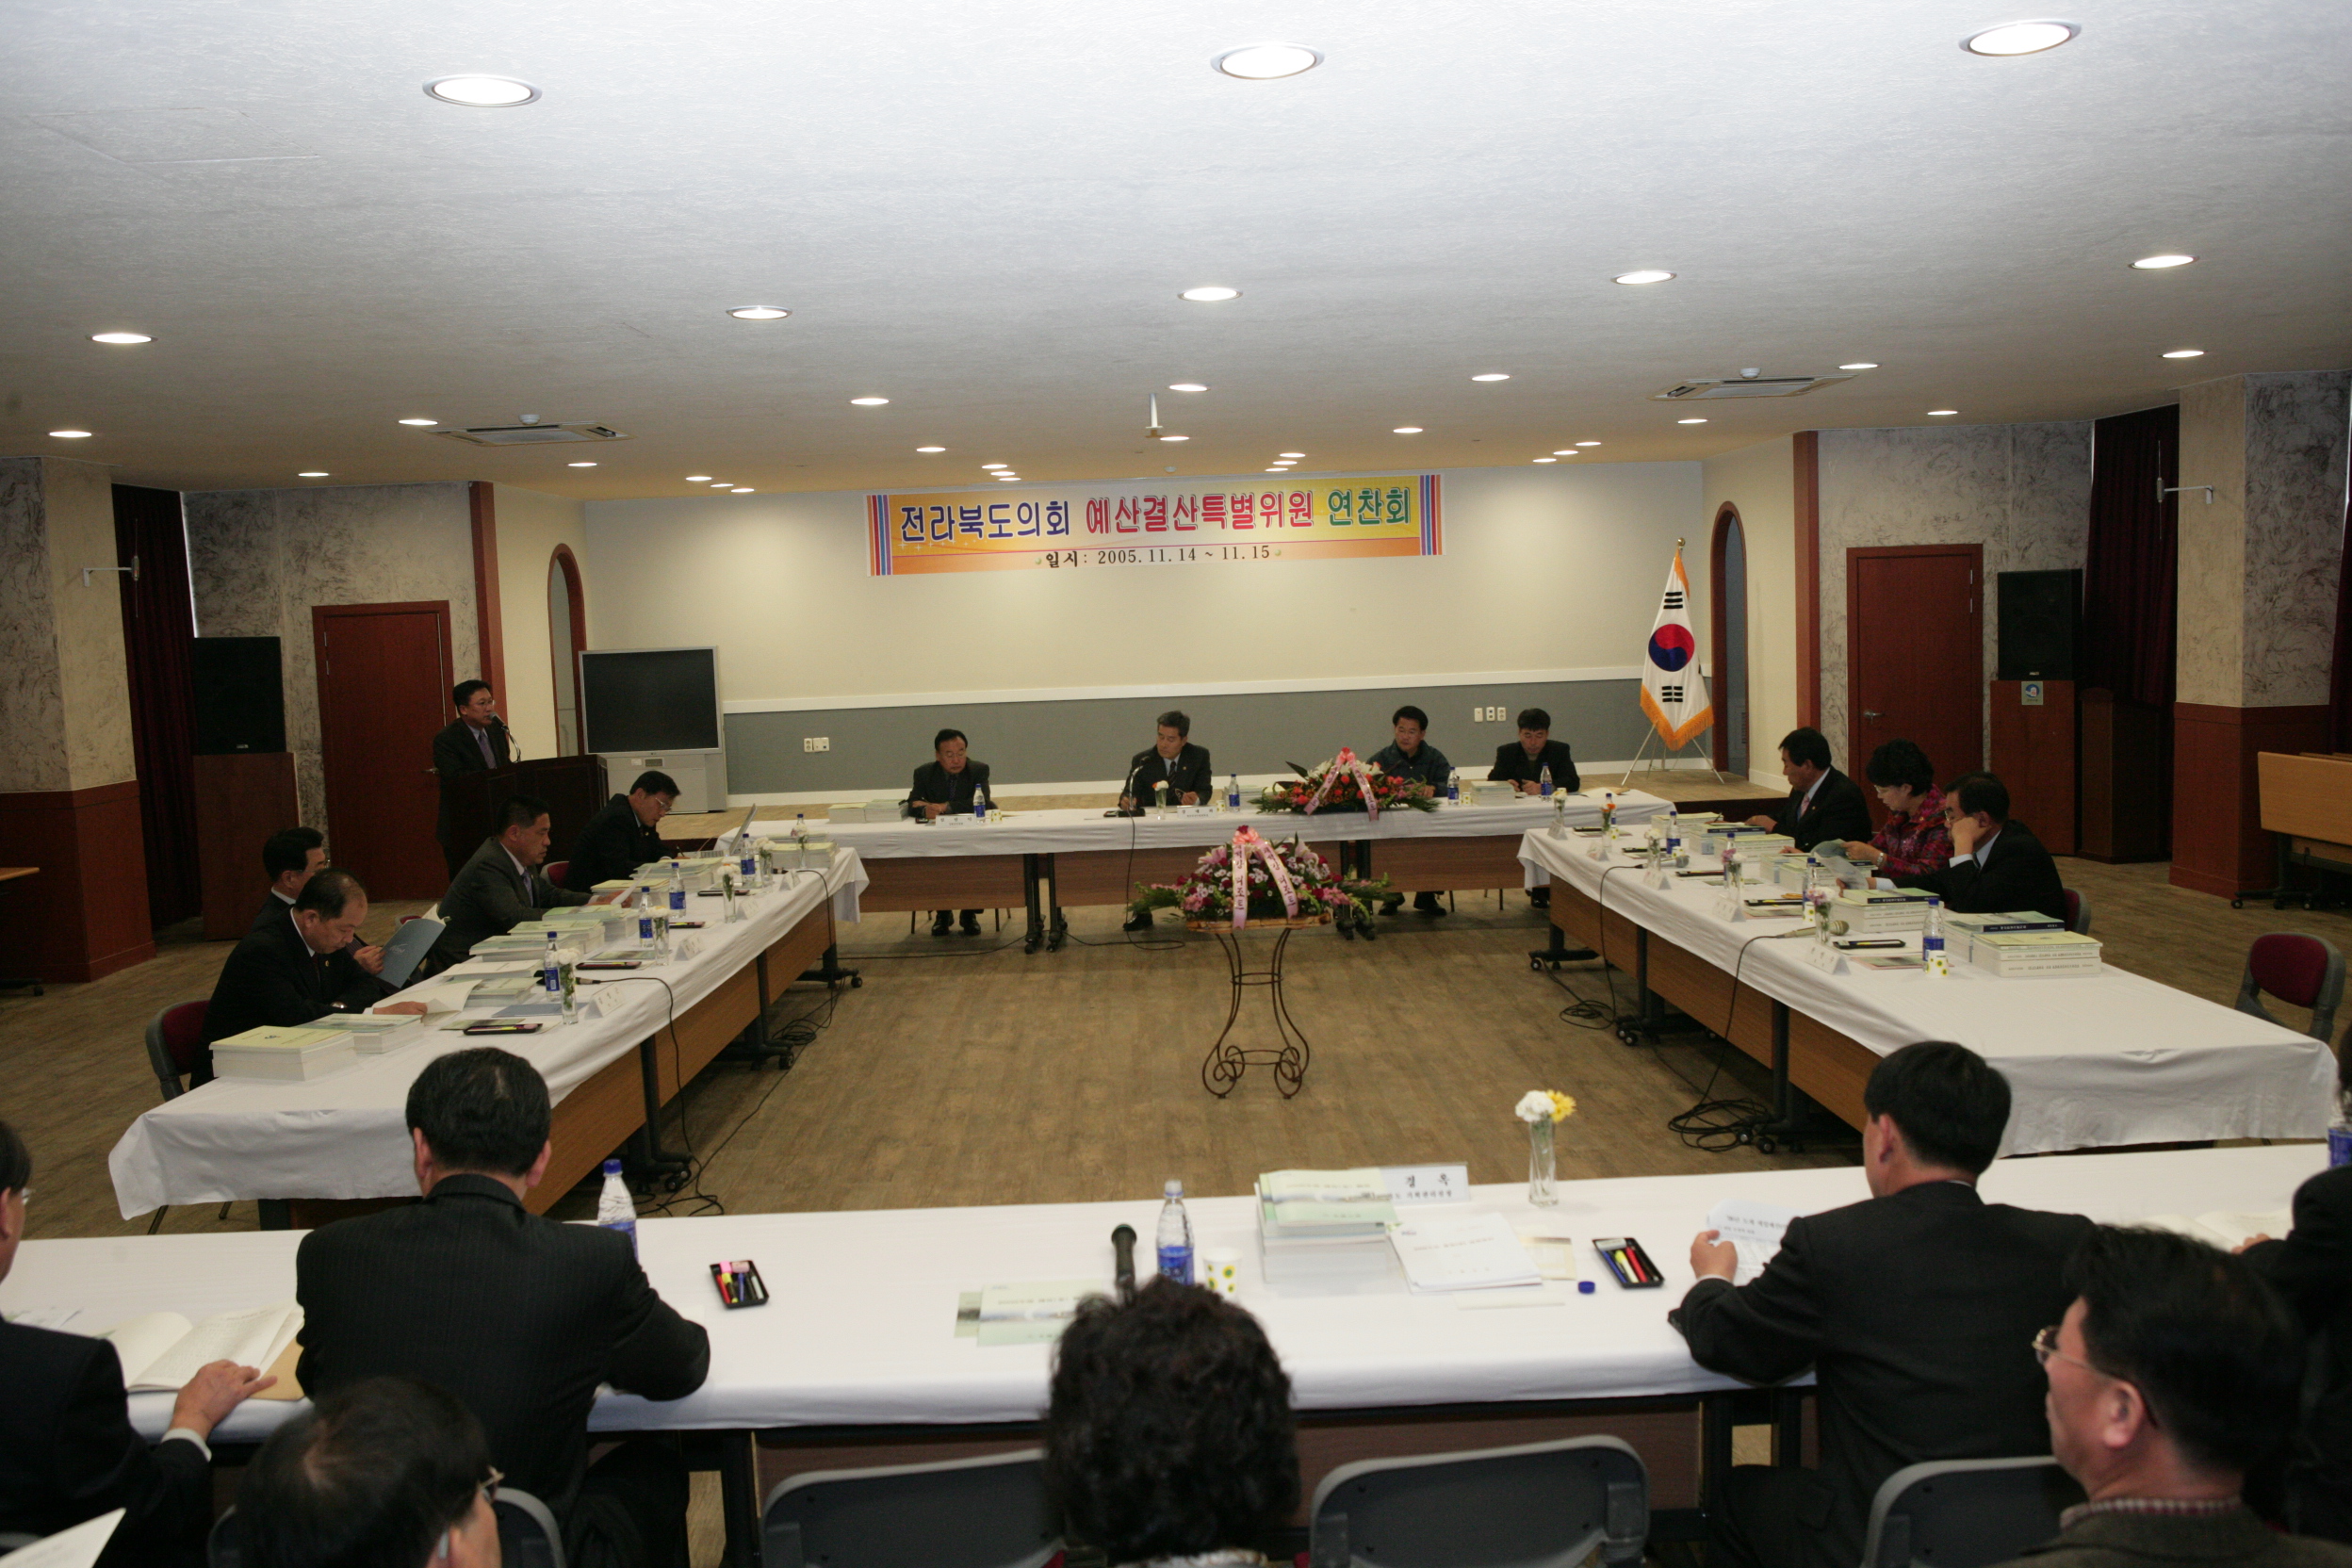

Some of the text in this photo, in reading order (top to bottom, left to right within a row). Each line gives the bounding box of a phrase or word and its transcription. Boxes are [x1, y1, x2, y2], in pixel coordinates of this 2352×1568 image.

[900, 487, 1412, 542] 전라북도의회 예산결산특별위원 연찬회
